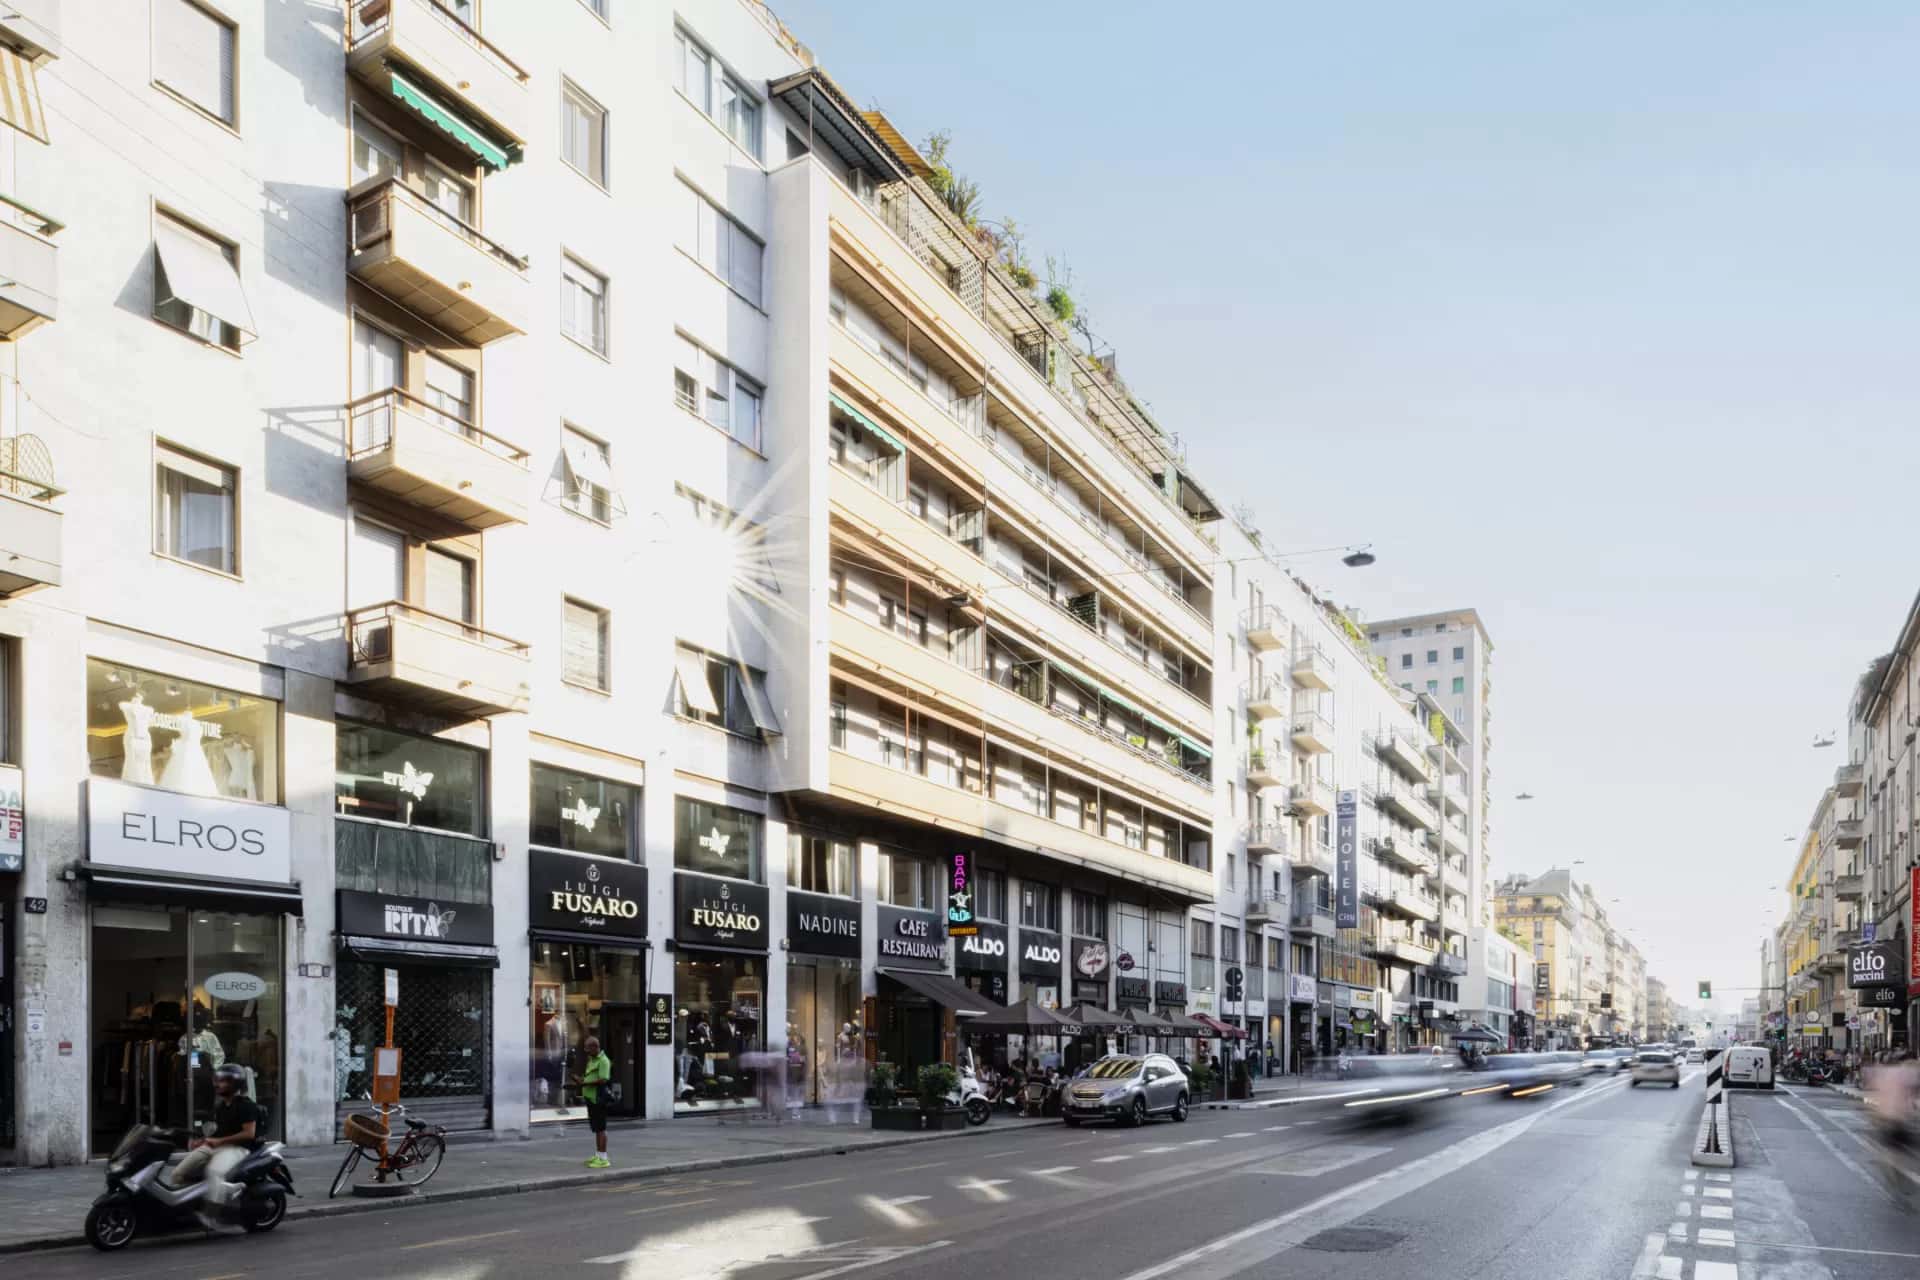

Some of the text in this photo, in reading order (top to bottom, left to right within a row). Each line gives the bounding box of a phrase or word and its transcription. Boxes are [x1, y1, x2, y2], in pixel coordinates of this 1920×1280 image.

[122, 811, 265, 855] ELROS
[954, 855, 966, 889] BAR
[1341, 825, 1353, 906] HOTEL
[565, 880, 620, 897] LUIGI
[29, 900, 46, 911] 42
[551, 890, 638, 918] FUSARO
[703, 898, 746, 913] LUIGI
[385, 911, 440, 937] RITA
[693, 908, 760, 932] FUSARO
[800, 913, 857, 937] NADINE
[883, 939, 945, 959] RESTAURANT
[963, 936, 1004, 956] ALDO
[1025, 944, 1060, 963] ALDO
[1853, 950, 1885, 971] elfo
[215, 981, 257, 991] ELROS
[1853, 969, 1885, 984] puccini
[1875, 988, 1895, 1001] elfo
[1061, 1024, 1082, 1034] ALDO
